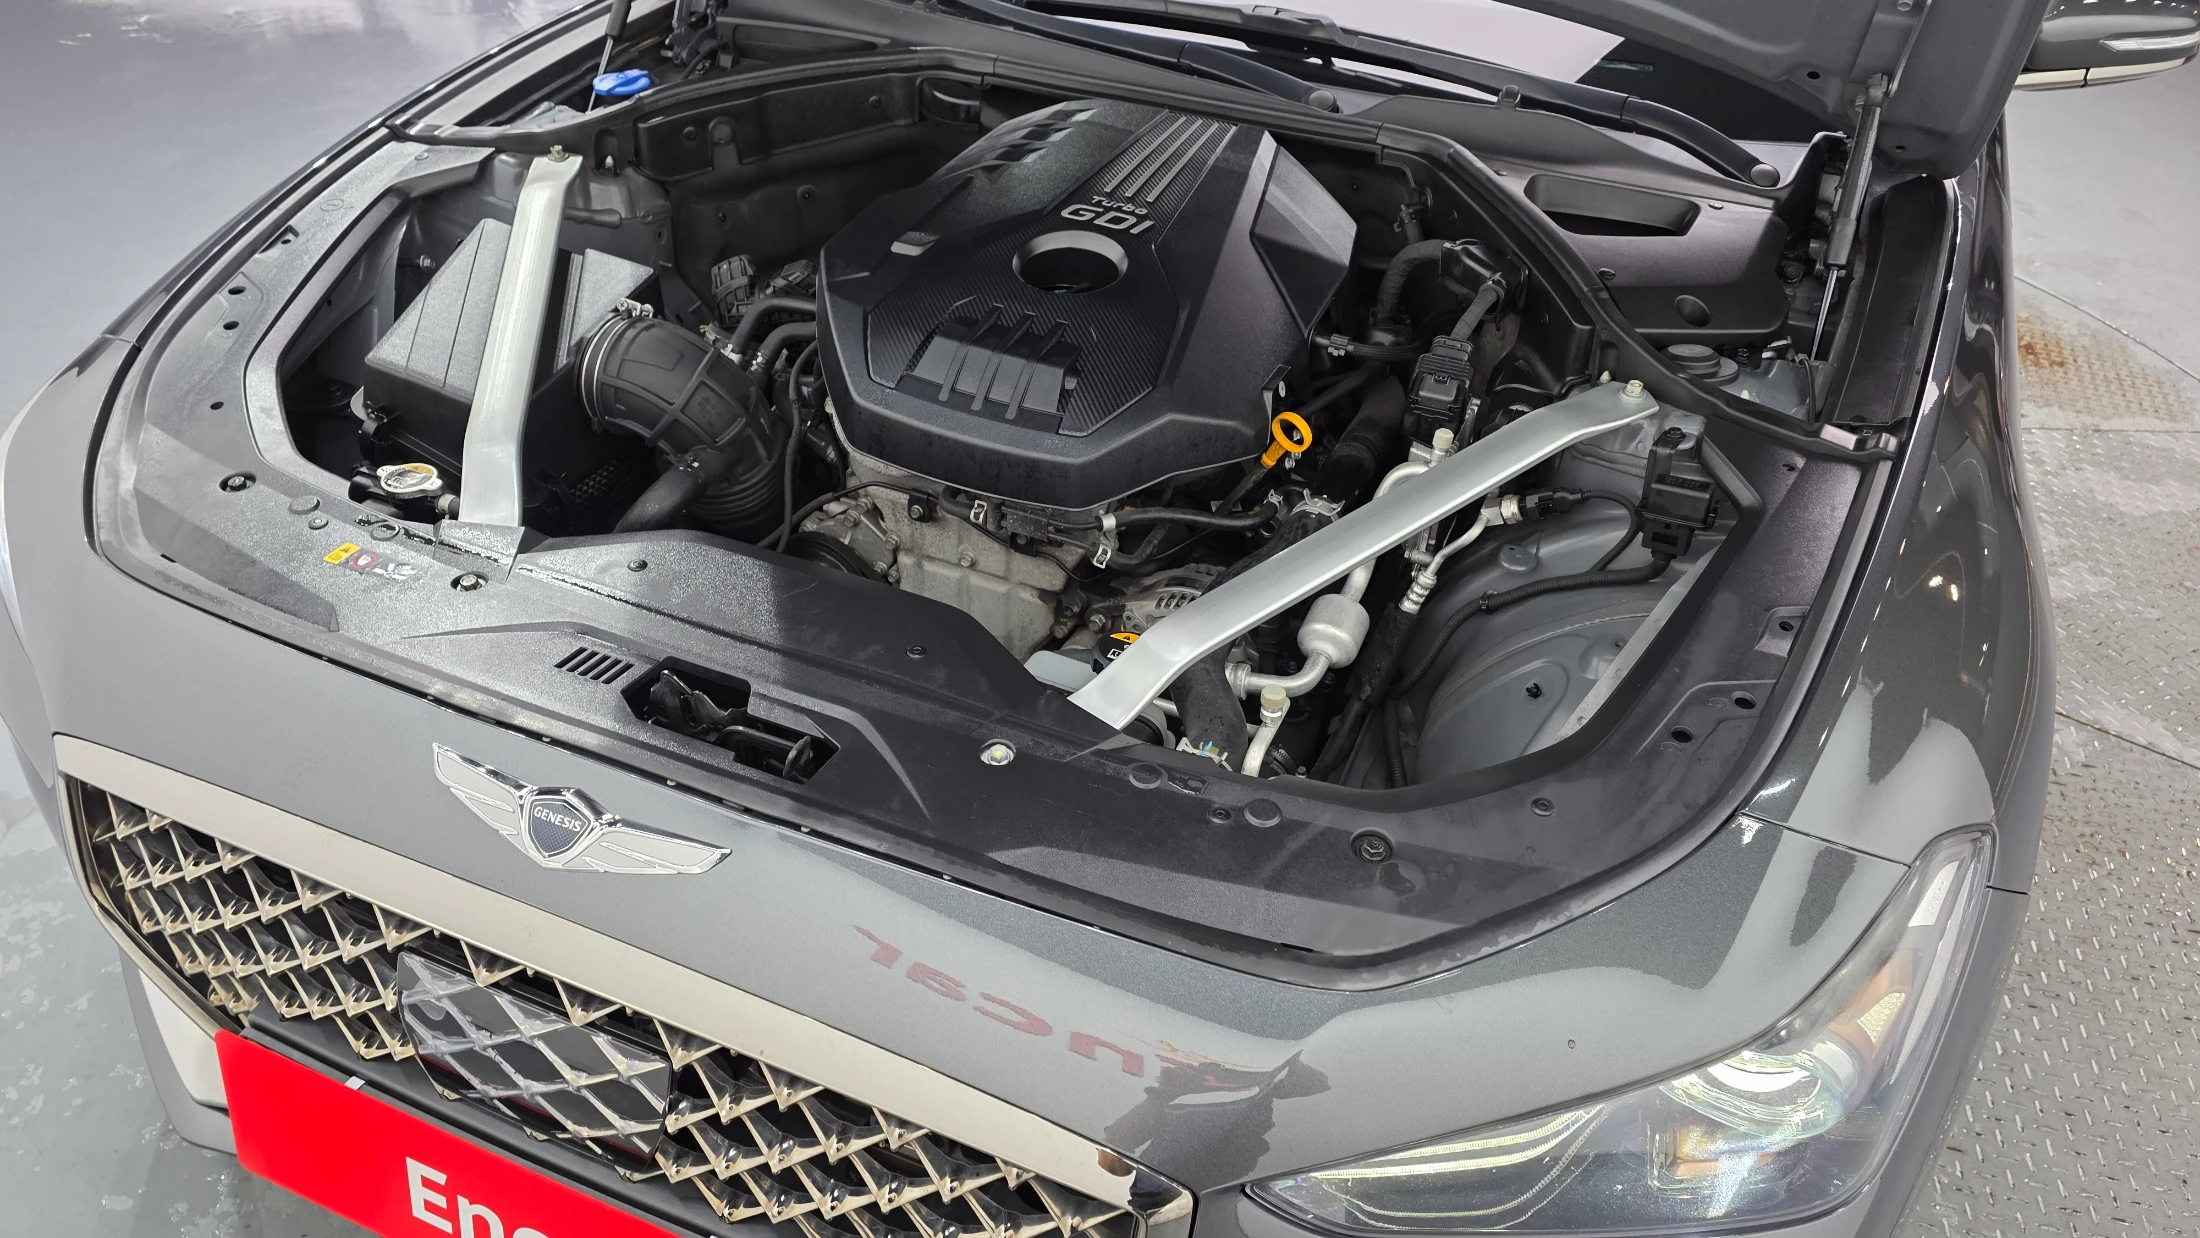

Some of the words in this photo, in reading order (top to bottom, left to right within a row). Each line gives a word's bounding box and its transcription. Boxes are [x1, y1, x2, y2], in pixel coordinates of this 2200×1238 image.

[1091, 195, 1149, 215] Turbo
[1061, 204, 1155, 235] GDI
[533, 806, 582, 832] GENESIS
[405, 1156, 549, 1238] En
